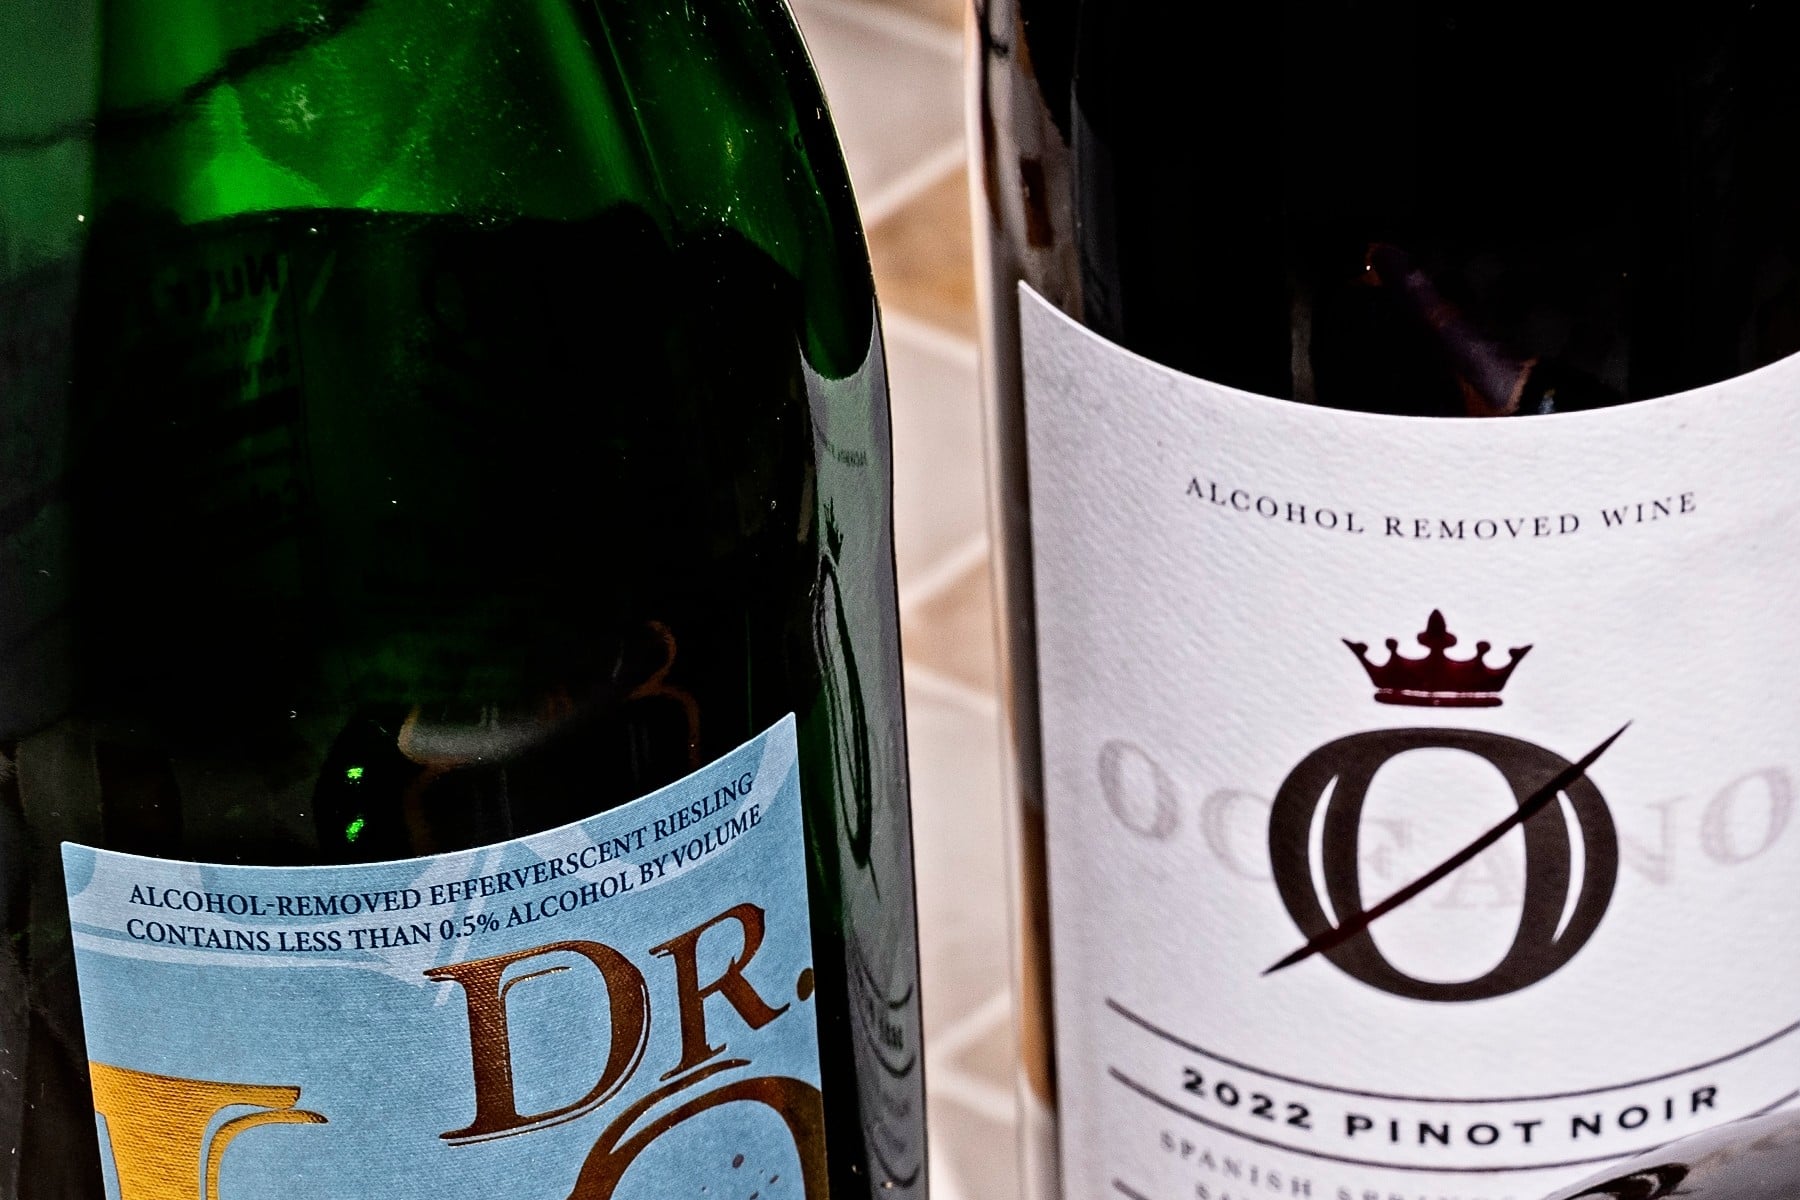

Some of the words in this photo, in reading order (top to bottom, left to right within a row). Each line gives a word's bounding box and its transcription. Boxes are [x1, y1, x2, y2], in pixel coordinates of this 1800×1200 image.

[1185, 476, 1366, 535] ALCOHOL
[1384, 512, 1582, 540] REMOVED
[1599, 490, 1699, 529] WINE
[126, 918, 271, 951] CONTAINS
[279, 931, 342, 952] LESS
[348, 922, 433, 950] THAN
[439, 911, 500, 941] 0.5%
[505, 872, 634, 928] ALCOHOL
[639, 854, 674, 885] BY
[670, 804, 763, 868] VOLUME
[129, 884, 421, 917] ALCOHOL-REMOVED
[429, 826, 649, 905] EFFERVERSCENT
[653, 771, 754, 842] RIESLING
[423, 902, 815, 1142] DR.
[1158, 1129, 1314, 1199] SPANISH
[1181, 1066, 1313, 1130] 2022
[1344, 1112, 1542, 1148] PINOT
[1570, 1085, 1719, 1139] NOIR
